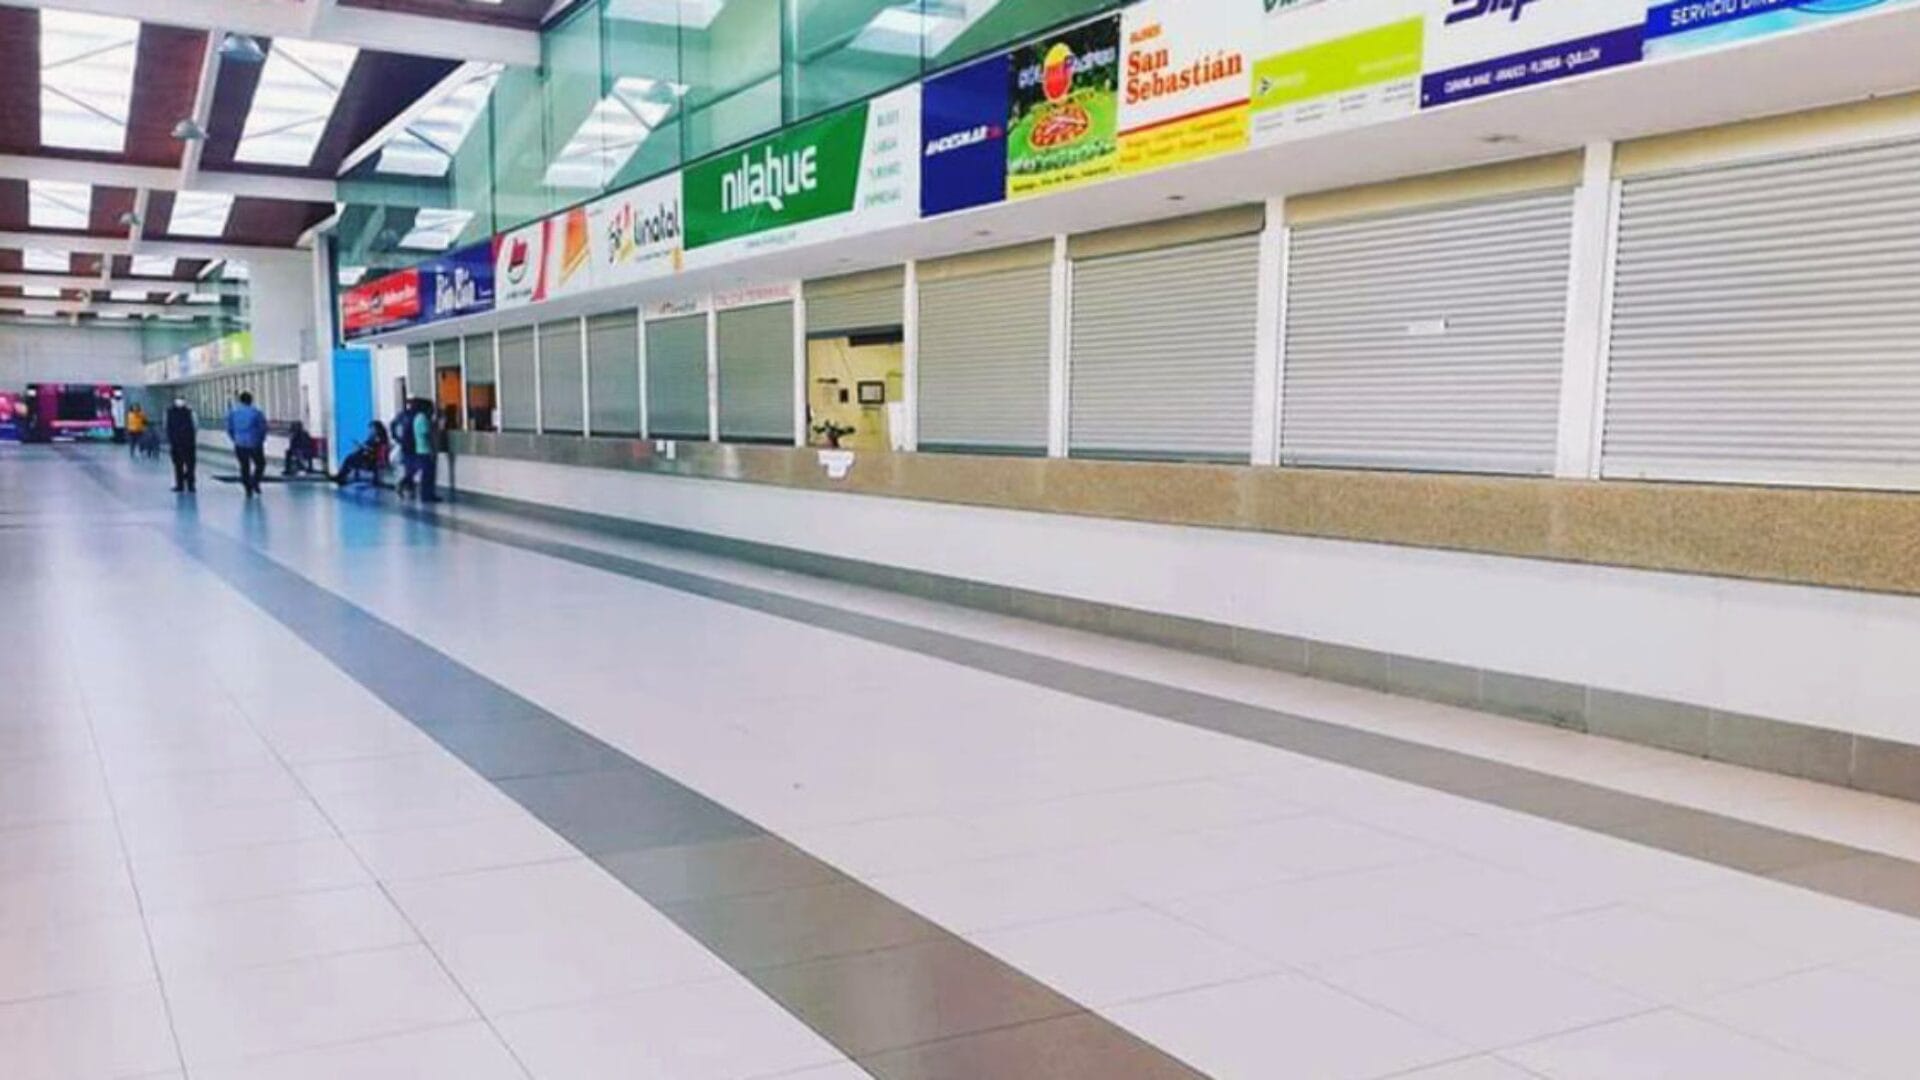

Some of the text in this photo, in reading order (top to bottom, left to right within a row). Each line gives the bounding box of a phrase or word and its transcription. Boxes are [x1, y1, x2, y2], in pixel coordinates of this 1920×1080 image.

[1669, 0, 1738, 27] SERVICIO
[1127, 48, 1169, 77] San
[1125, 50, 1243, 105] Sebastián
